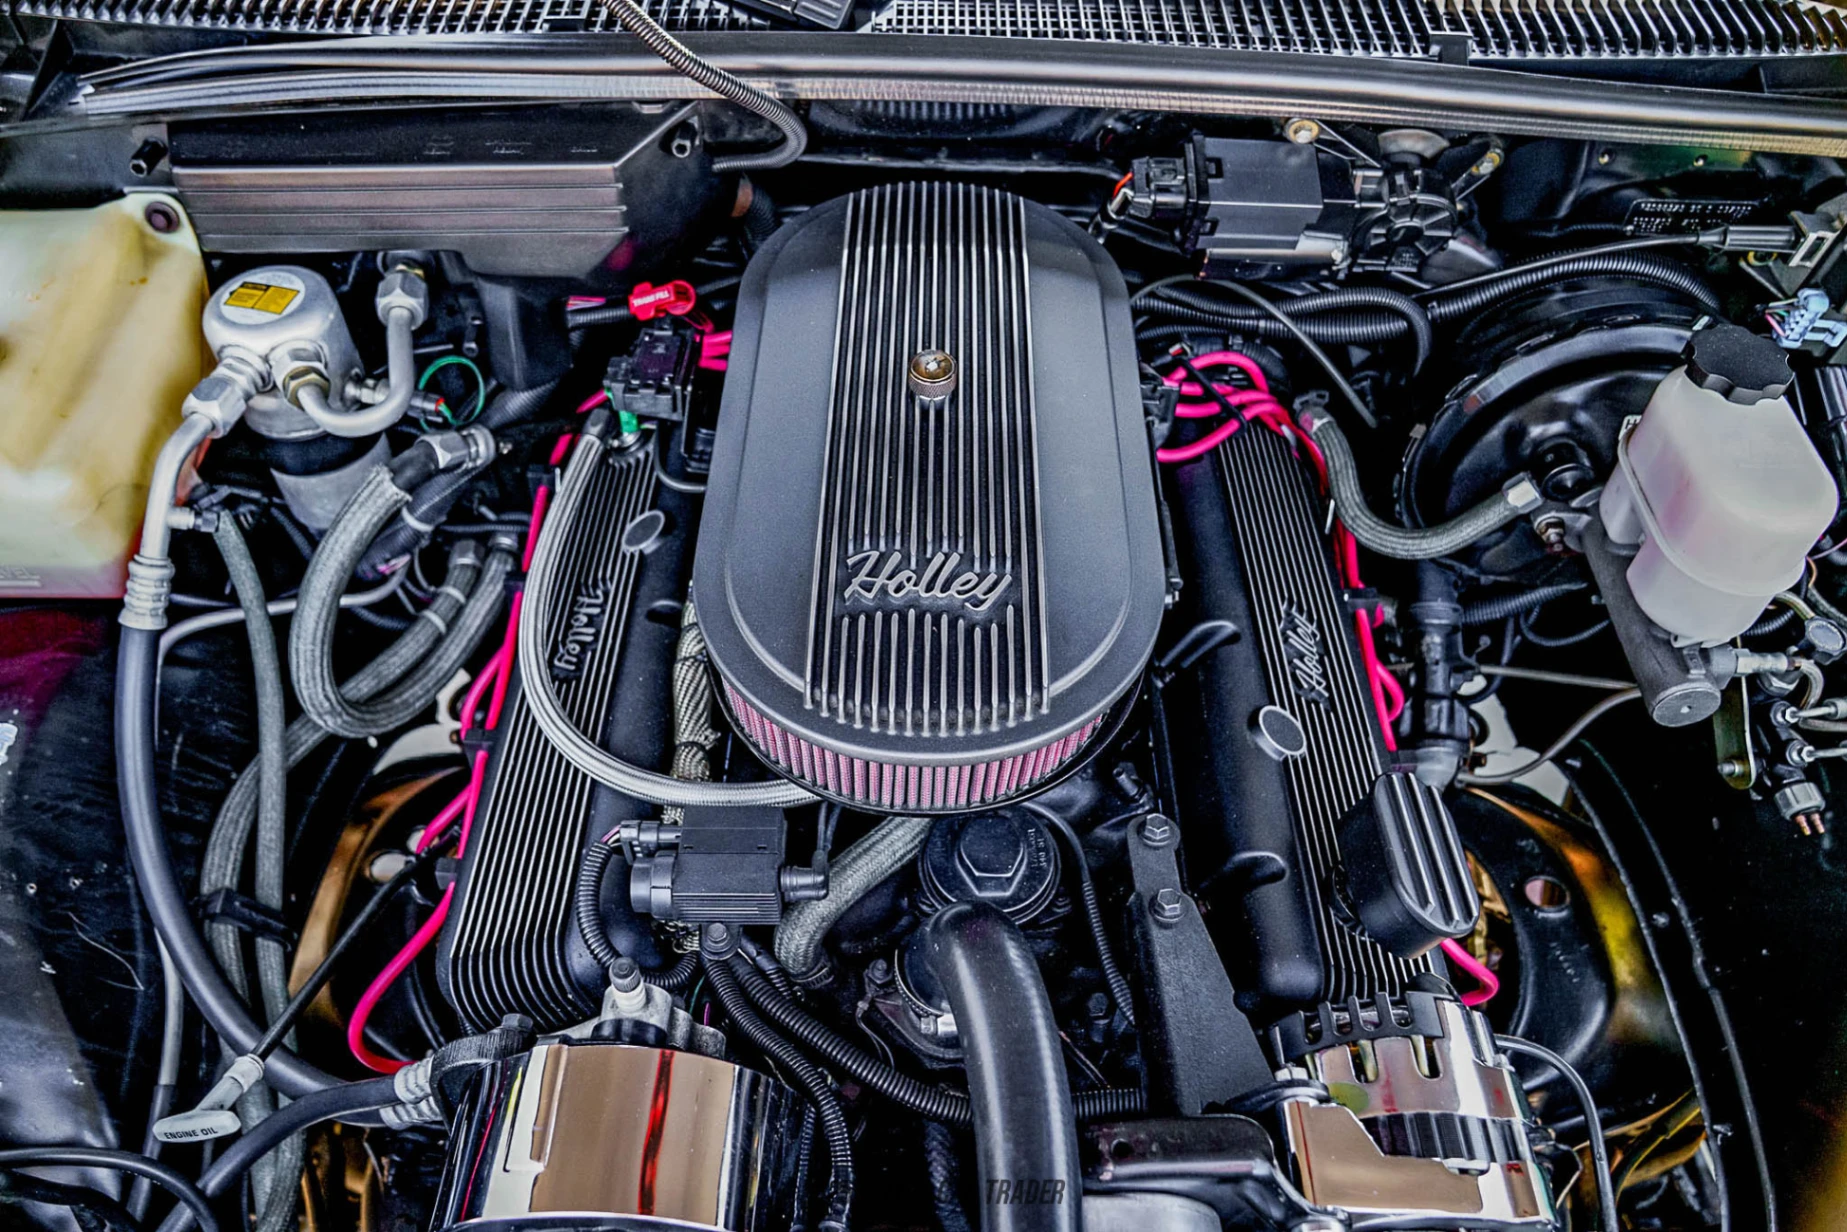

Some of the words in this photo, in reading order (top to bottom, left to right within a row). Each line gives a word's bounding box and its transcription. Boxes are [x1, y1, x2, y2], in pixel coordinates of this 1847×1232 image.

[843, 550, 1013, 611] Holley
[553, 589, 604, 671] Holley
[1286, 611, 1329, 698] Holley
[164, 1129, 199, 1140] ENGINE
[200, 1126, 219, 1136] OIL
